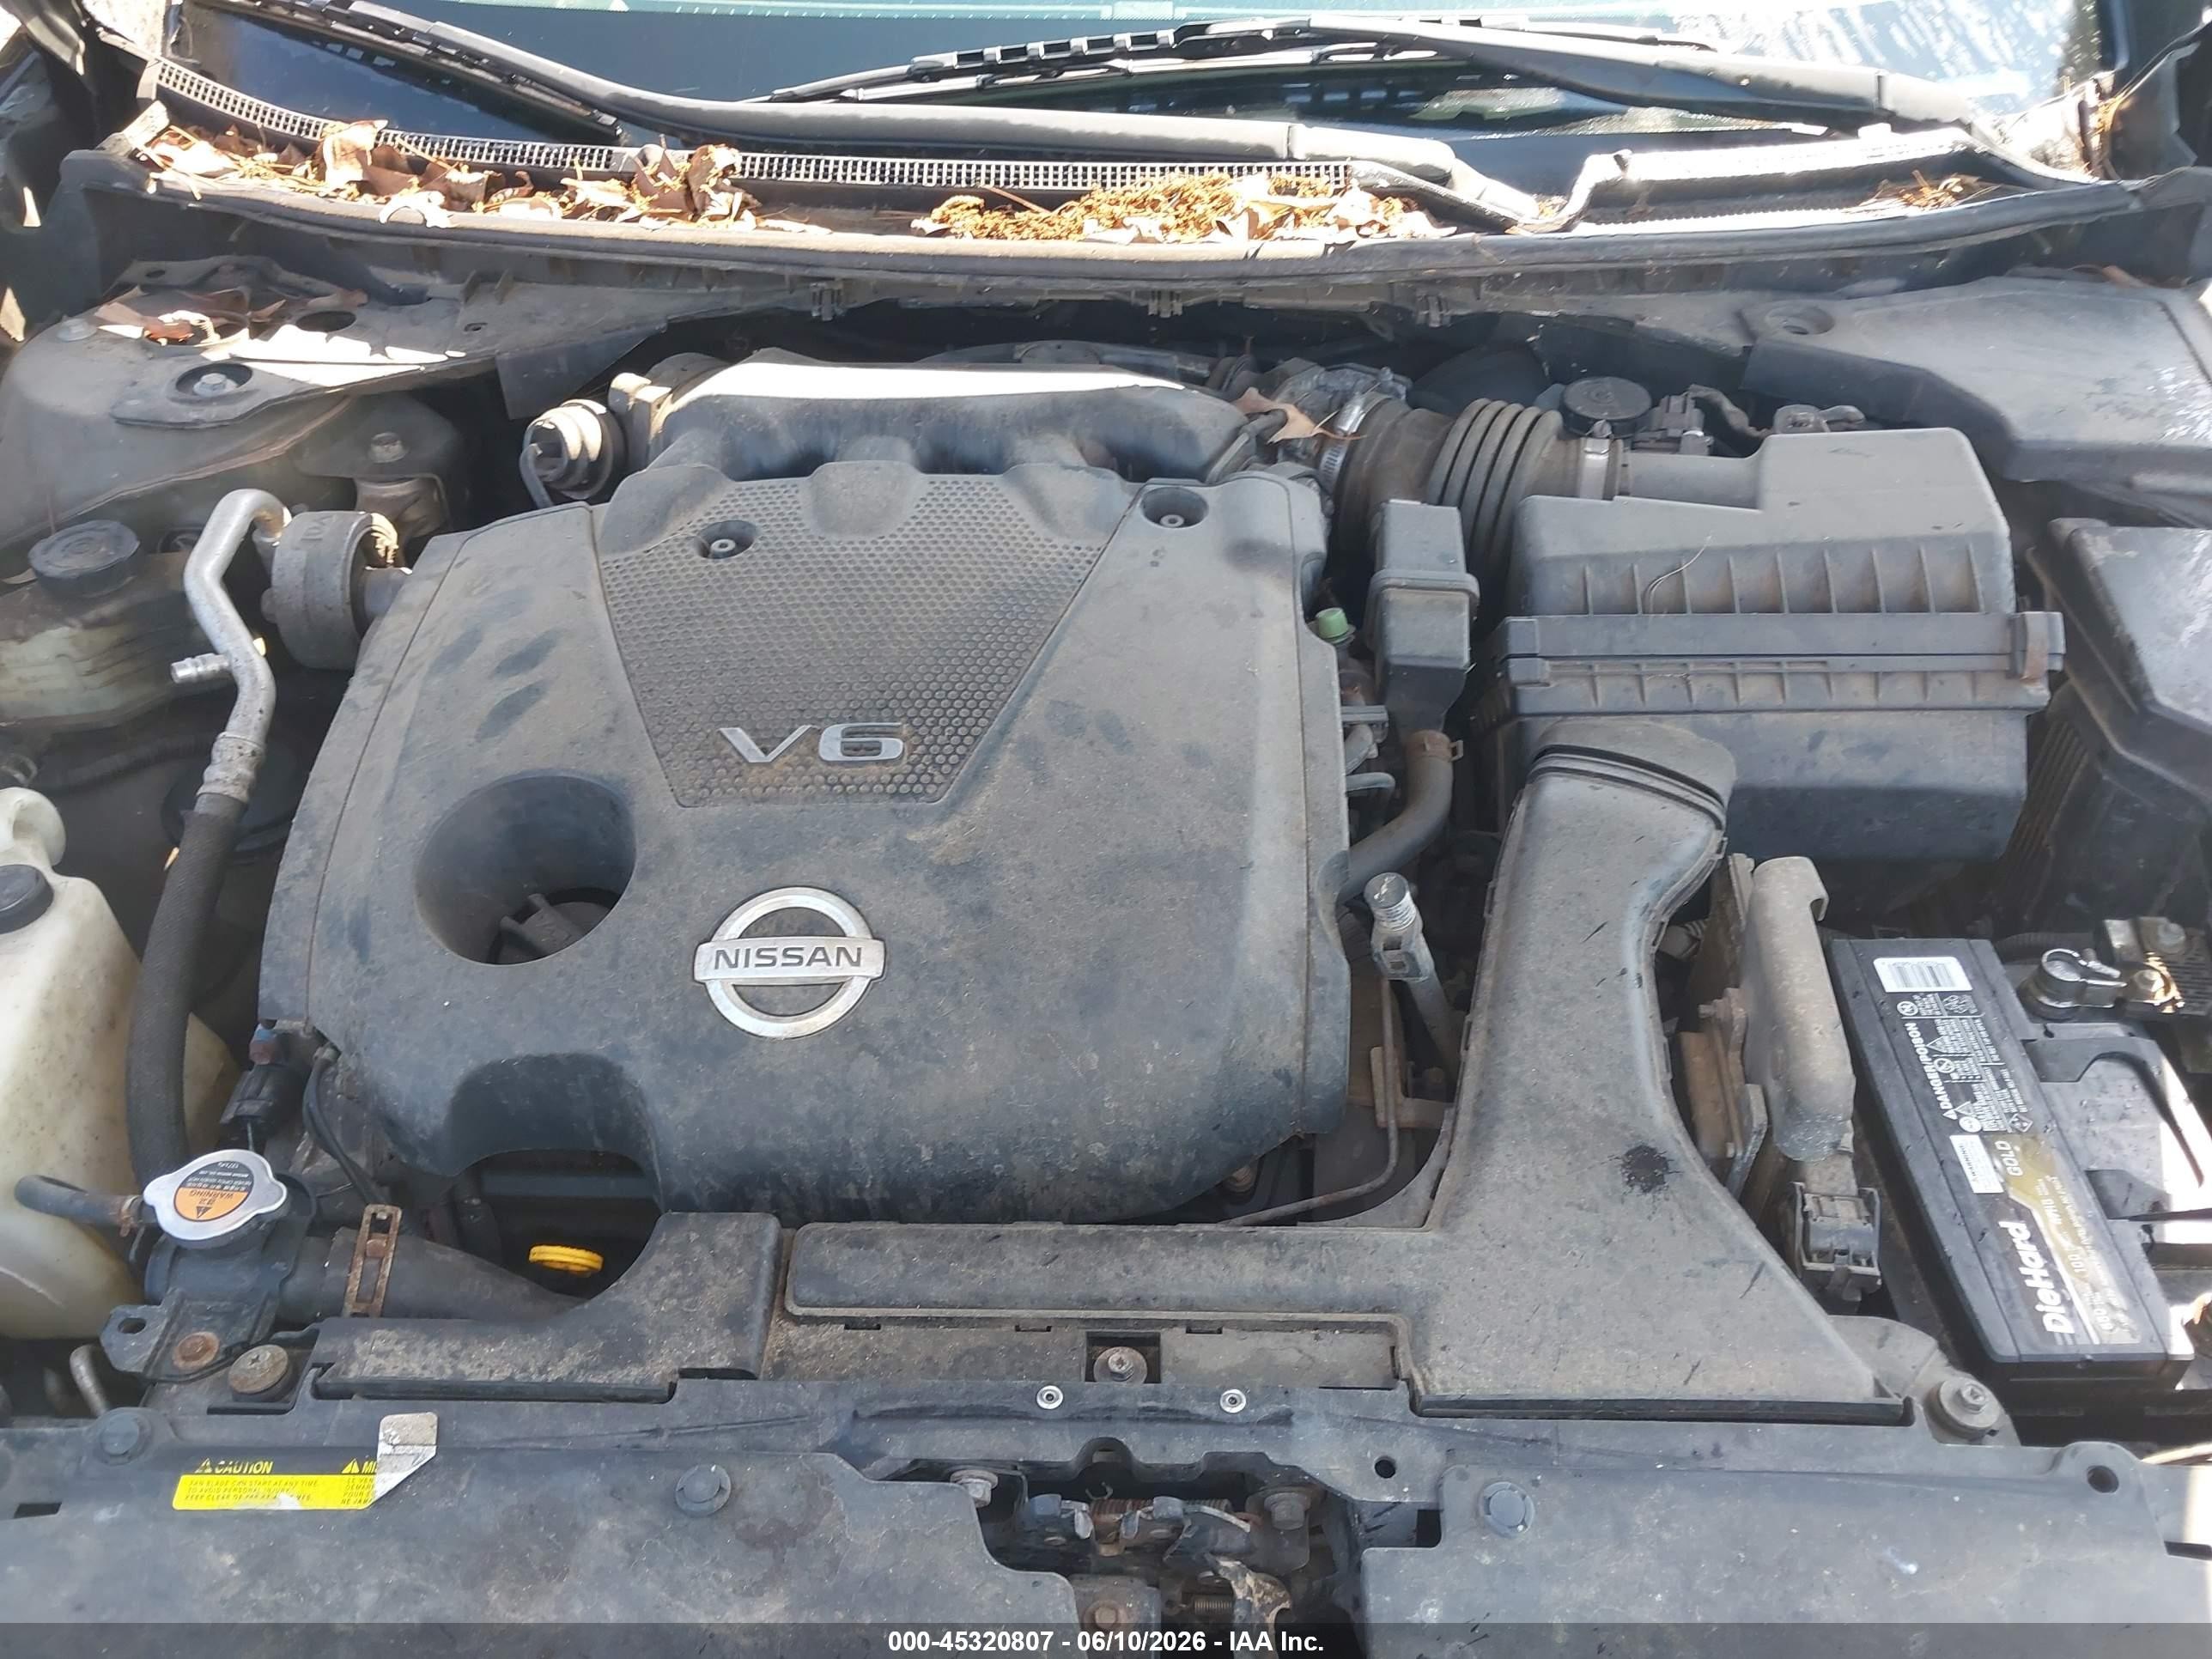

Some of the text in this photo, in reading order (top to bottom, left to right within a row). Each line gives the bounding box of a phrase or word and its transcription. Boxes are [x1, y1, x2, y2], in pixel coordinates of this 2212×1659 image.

[718, 723, 903, 763] V6
[714, 946, 862, 970] NISSAN
[1904, 1022, 1953, 1109] DANGER/POISON
[1995, 1141, 2023, 1176] GOLD
[190, 1189, 234, 1199] WARNING
[1998, 1220, 2075, 1334] DieHard
[2066, 1254, 2088, 1273] 100
[214, 1461, 273, 1474] CAUTION
